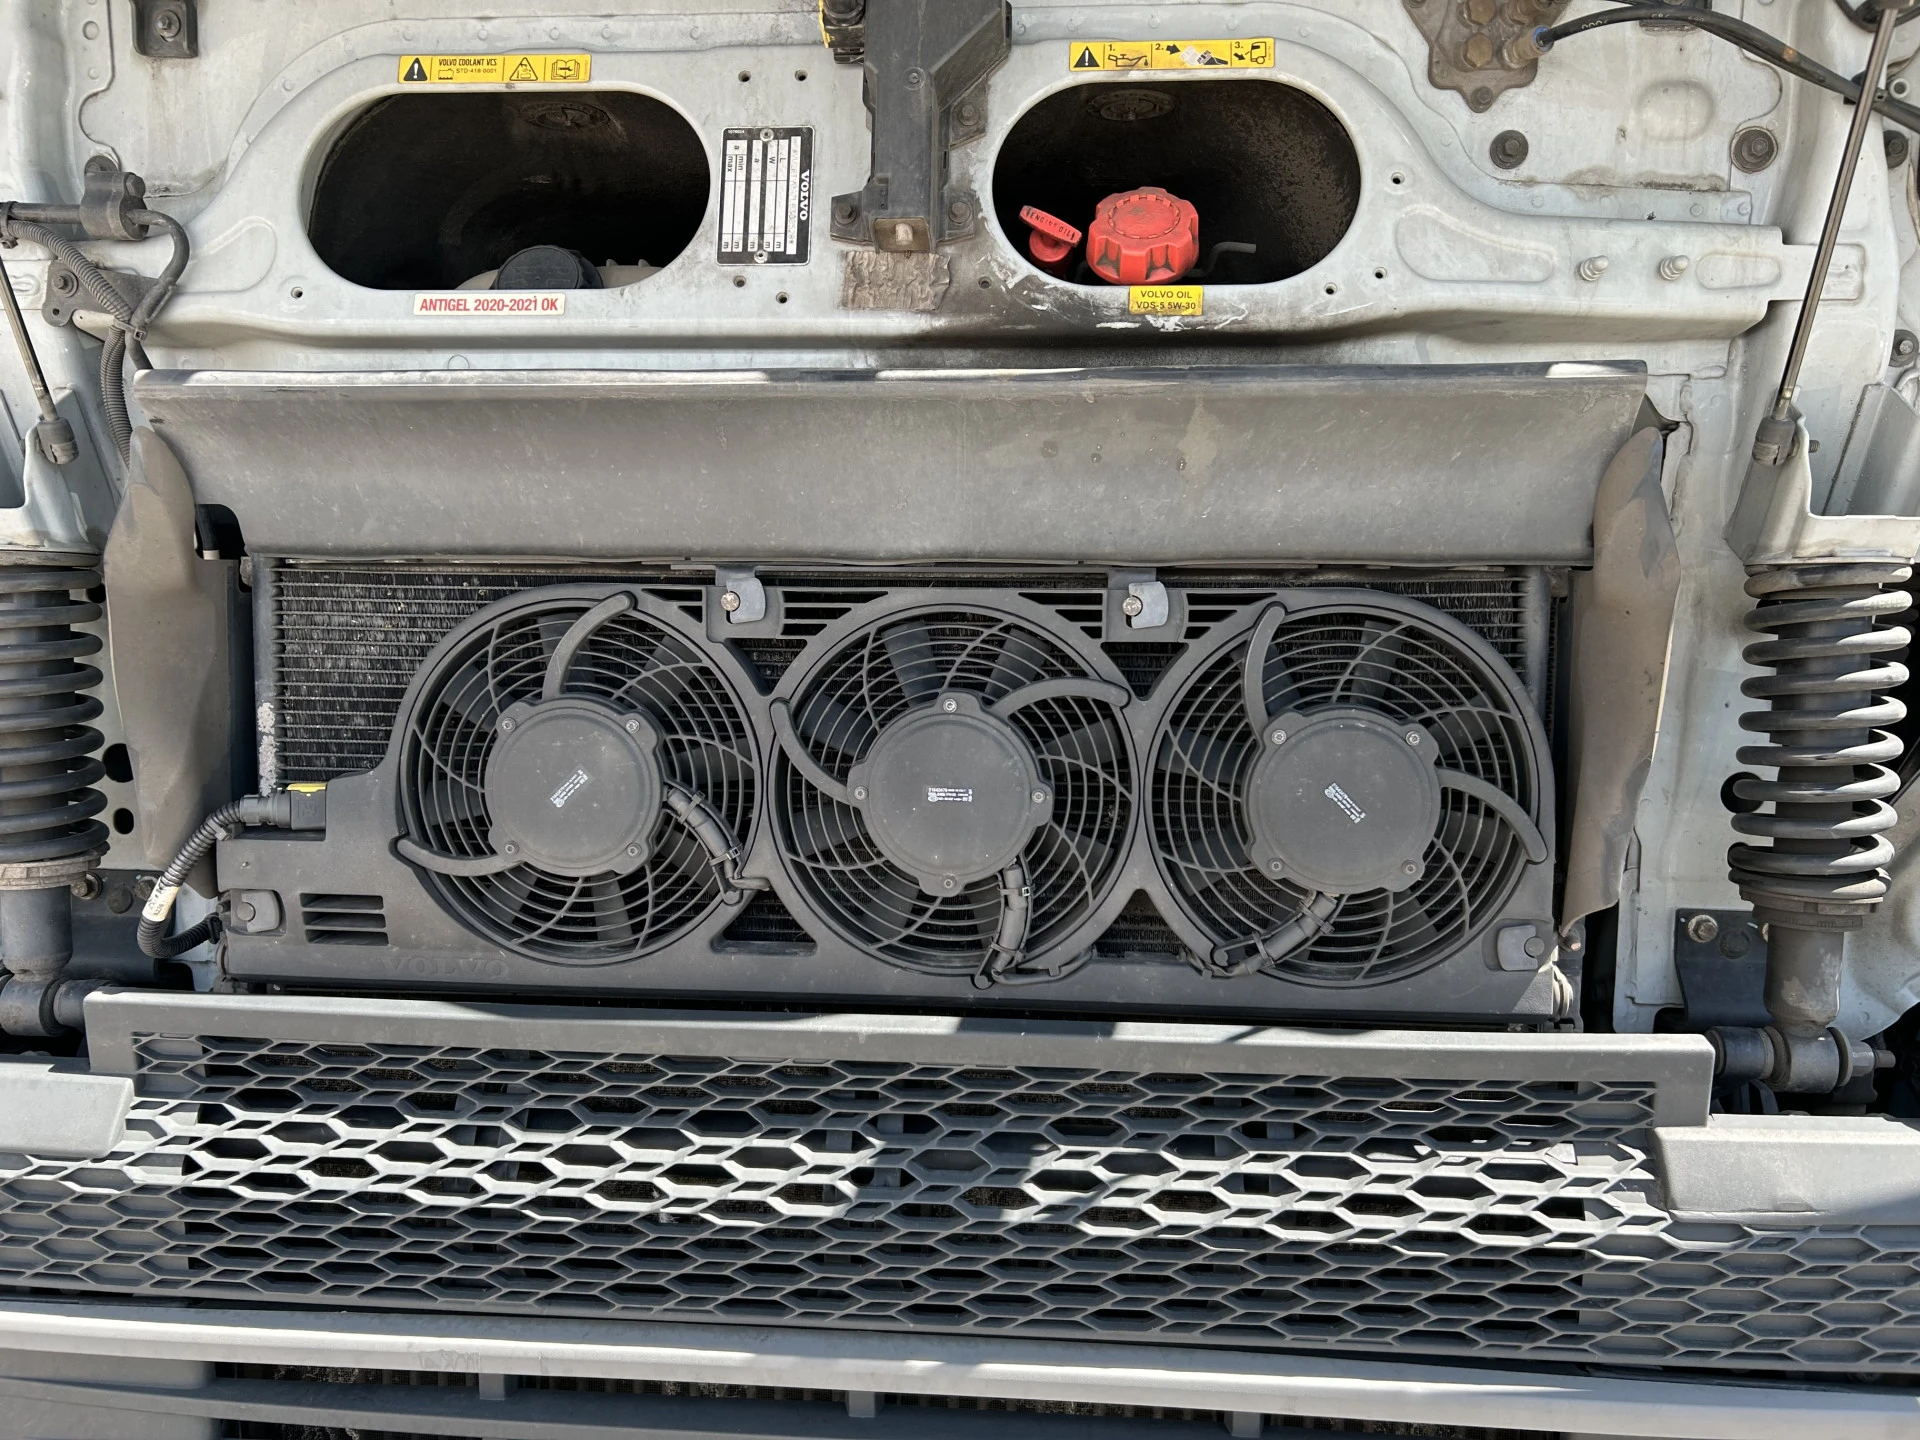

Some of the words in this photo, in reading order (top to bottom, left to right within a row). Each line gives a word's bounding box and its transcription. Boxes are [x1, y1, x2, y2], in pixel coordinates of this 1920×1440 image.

[1108, 43, 1115, 51] 1.
[1155, 43, 1164, 51] 2.
[1235, 41, 1244, 49] 3.
[439, 58, 457, 66] VOLVO
[458, 58, 485, 66] COOLANT
[486, 58, 497, 66] VCS
[768, 156, 776, 164] W
[800, 169, 810, 221] VOLVO
[1059, 226, 1071, 237] OIL
[723, 241, 729, 249] m
[733, 241, 739, 249] m
[749, 241, 755, 249] m
[764, 241, 771, 249] m
[775, 241, 781, 249] m
[1140, 290, 1174, 299] VOLVO
[1176, 291, 1192, 299] OIL
[420, 299, 470, 312] ANTIGEL
[474, 298, 538, 312] 2020-2021
[541, 298, 559, 311] OK
[1136, 301, 1165, 309] VDS-5
[1167, 301, 1196, 310] 5W-30
[376, 956, 508, 977] VOLVO
